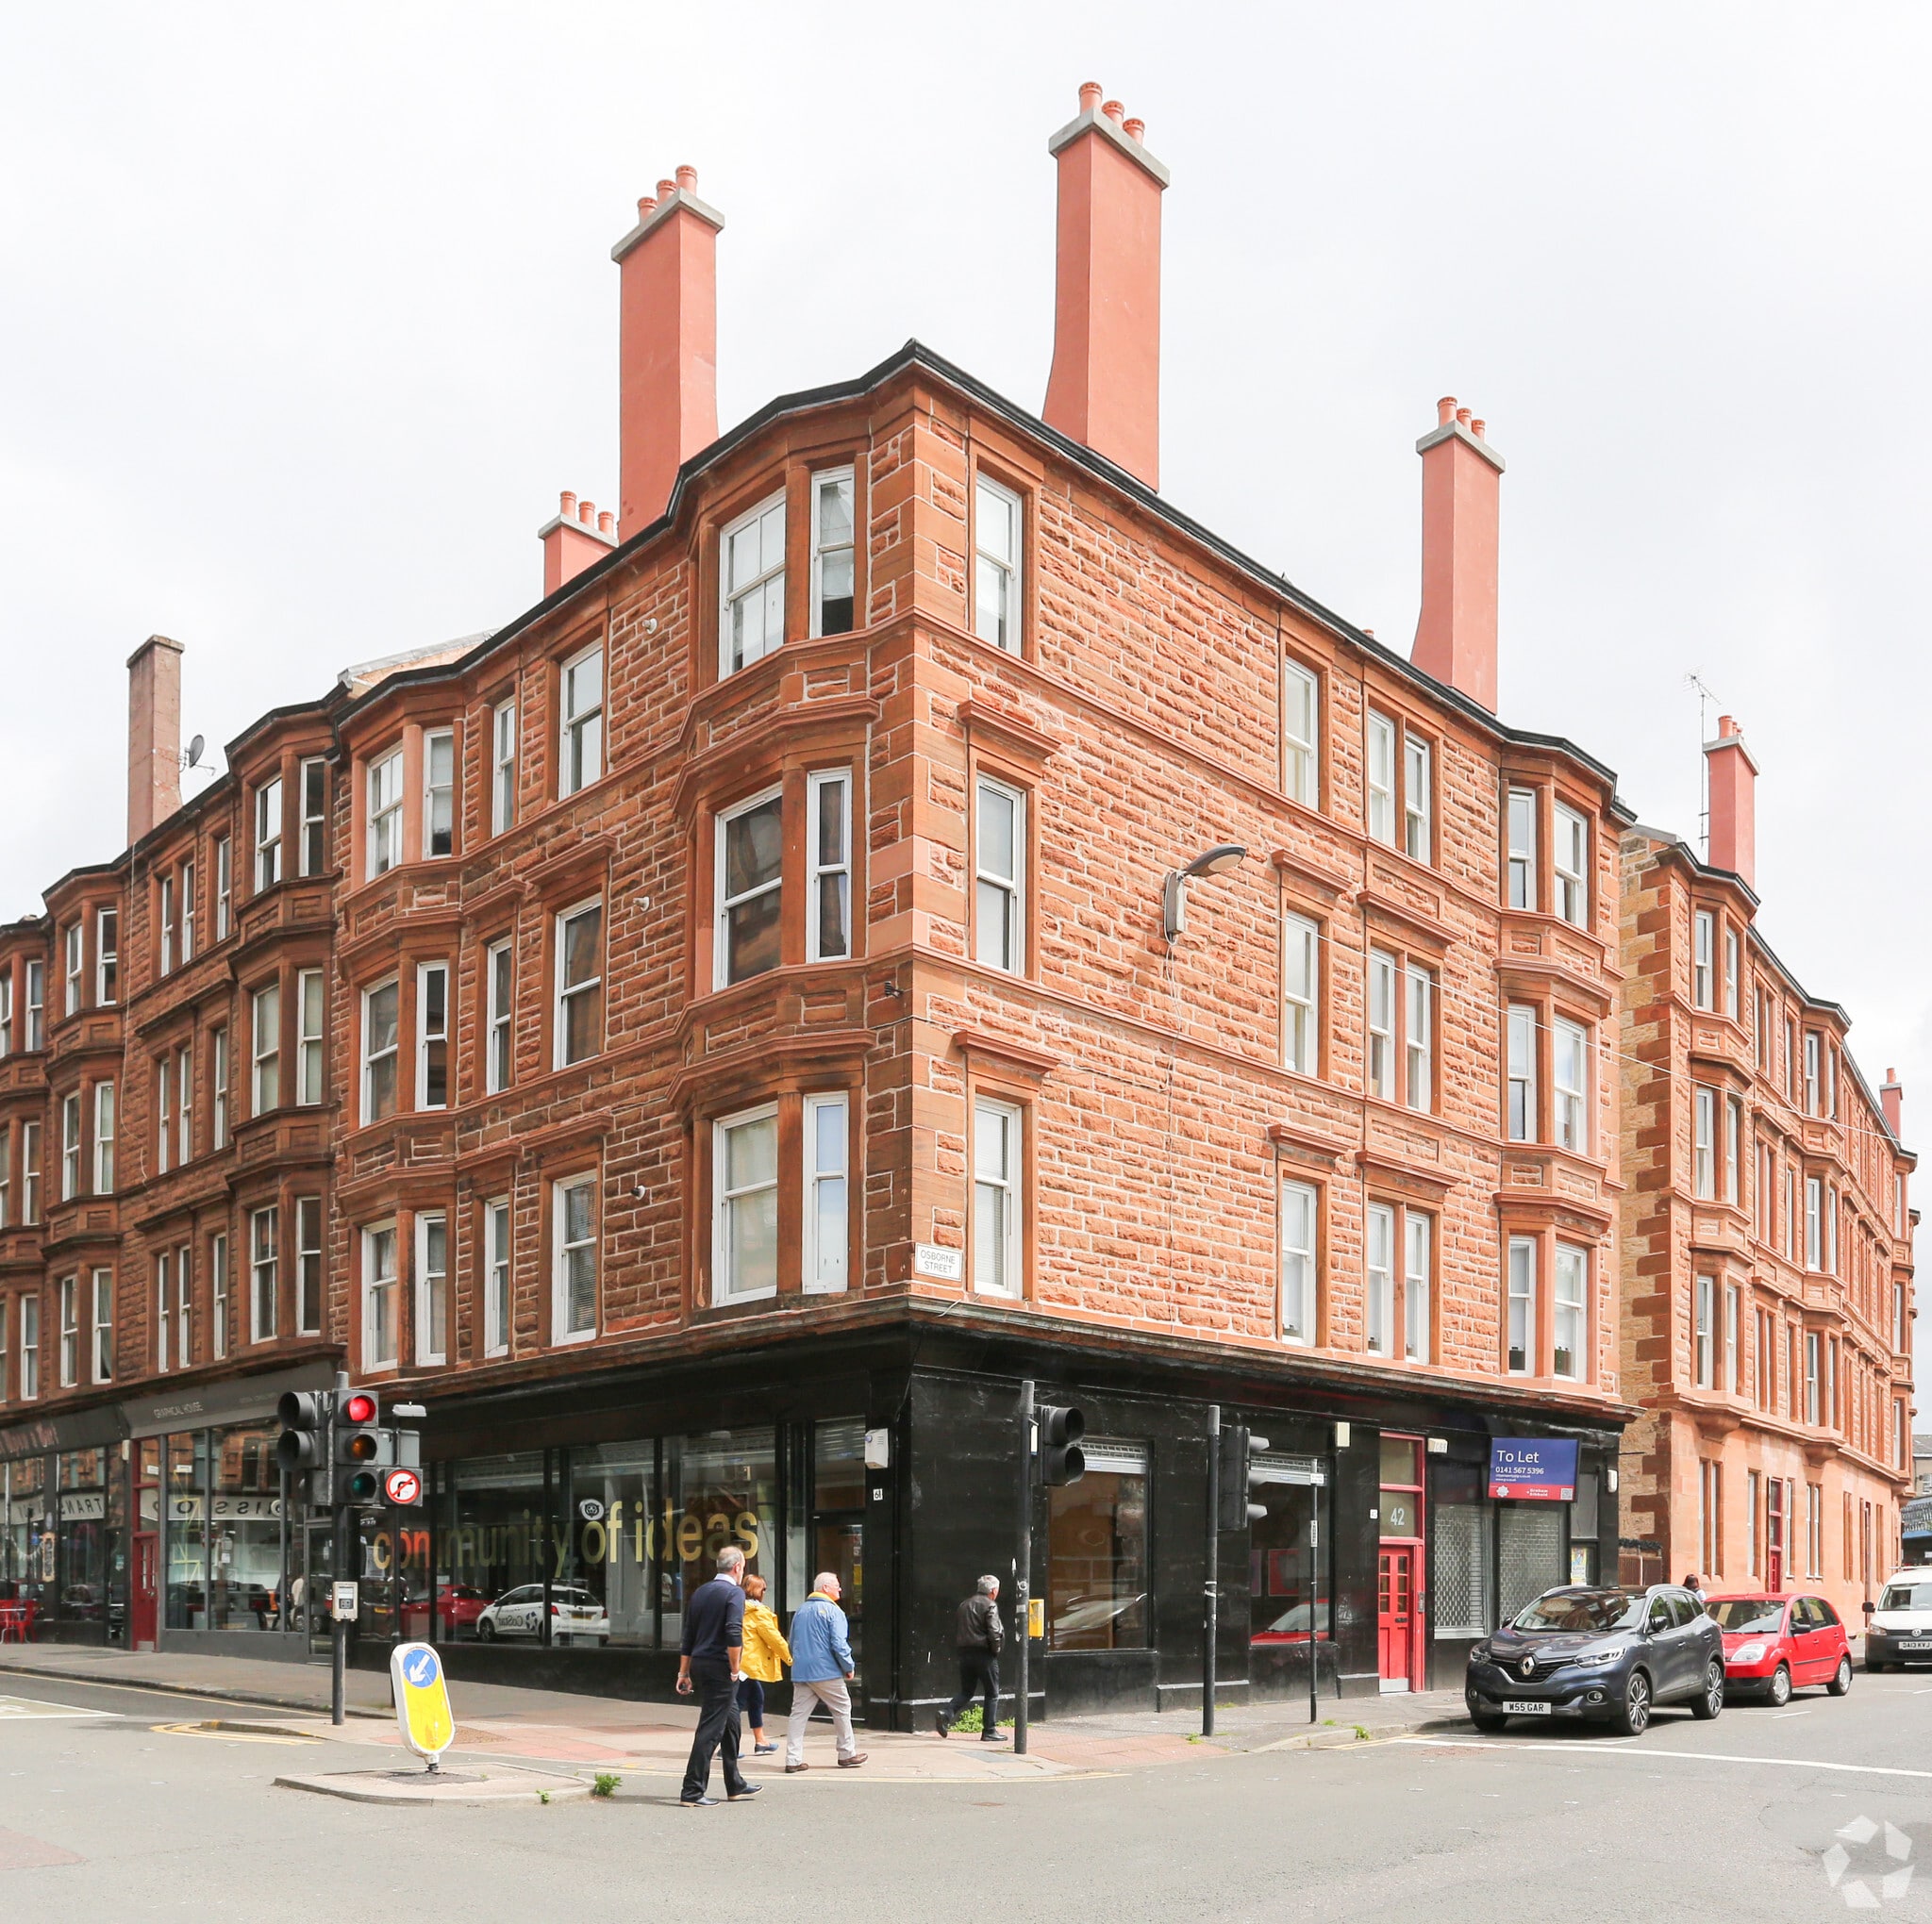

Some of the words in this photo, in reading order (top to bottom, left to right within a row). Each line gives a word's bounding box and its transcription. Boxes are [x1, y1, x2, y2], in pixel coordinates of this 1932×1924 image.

[920, 1250, 956, 1264] OSBORNE
[924, 1261, 952, 1273] STREET
[153, 1406, 184, 1418] GRAPHICAL
[184, 1402, 204, 1414] HOUSE
[1496, 1450, 1514, 1463] To
[1517, 1451, 1540, 1463] Let
[1495, 1466, 1511, 1474] 0141
[1390, 1507, 1405, 1526] 42
[581, 1501, 624, 1565] of
[635, 1497, 759, 1562] ideas
[1509, 1702, 1525, 1712] W55
[1526, 1703, 1544, 1712] GAR
